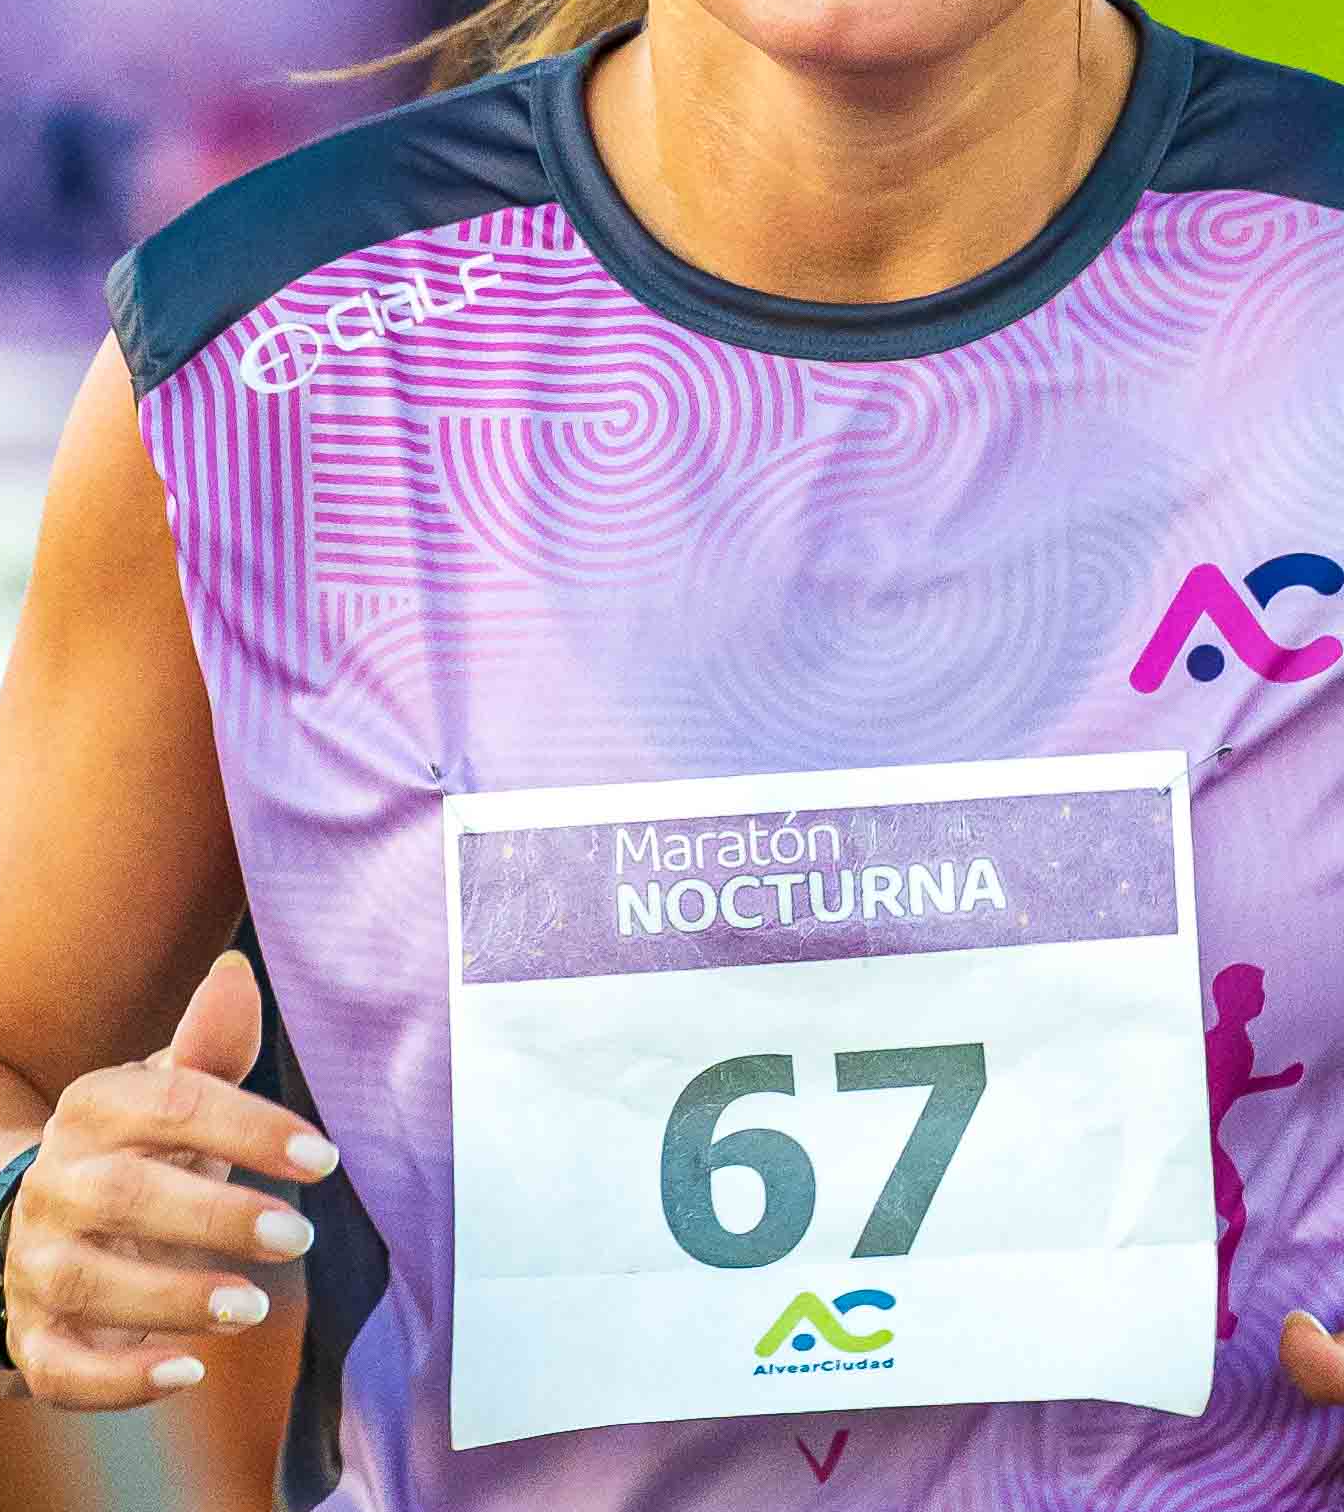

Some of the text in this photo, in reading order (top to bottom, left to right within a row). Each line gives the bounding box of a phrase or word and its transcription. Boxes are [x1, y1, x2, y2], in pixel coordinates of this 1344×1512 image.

[615, 810, 842, 874] Maratón
[616, 857, 1008, 937] NOCTURNA
[660, 1043, 988, 1269] 67
[753, 1357, 894, 1376] AlvearCiudad
